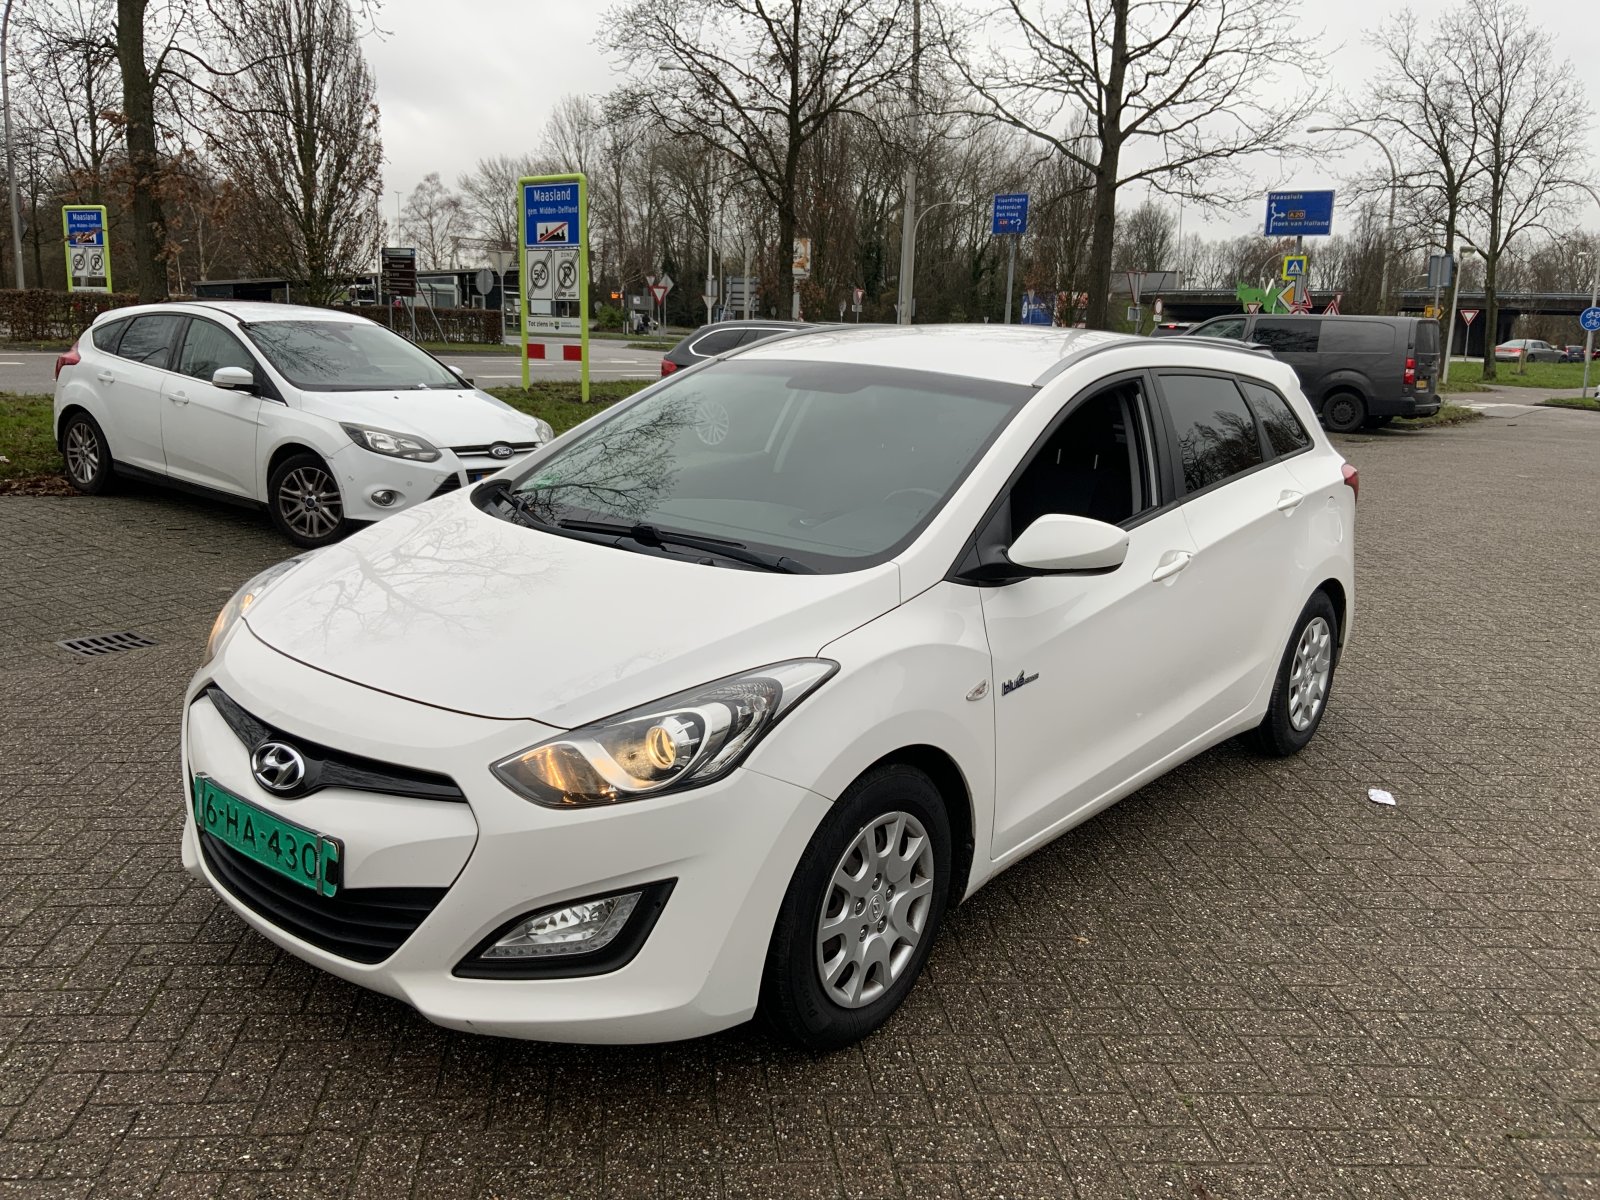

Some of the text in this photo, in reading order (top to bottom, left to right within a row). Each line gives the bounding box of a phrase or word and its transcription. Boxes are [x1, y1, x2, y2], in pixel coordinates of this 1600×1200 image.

[534, 188, 571, 202] Maasland
[540, 206, 578, 215] Midden-Delfland
[72, 213, 97, 221] Maasland
